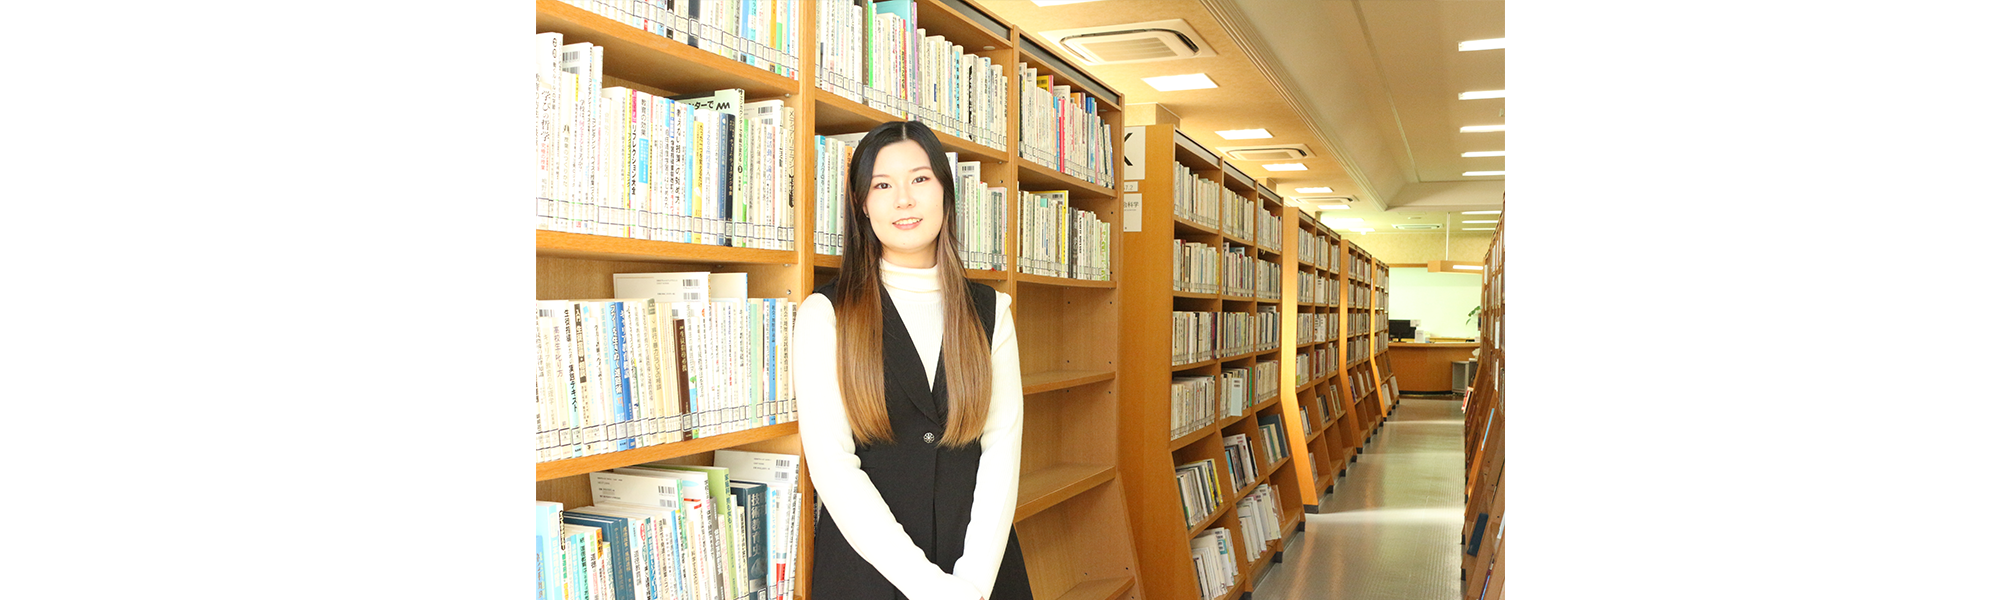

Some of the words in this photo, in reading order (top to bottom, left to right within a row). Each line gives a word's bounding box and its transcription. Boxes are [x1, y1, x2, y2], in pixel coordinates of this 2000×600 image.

[541, 90, 550, 142] 学びの哲学
[750, 493, 760, 557] 技術教育史
